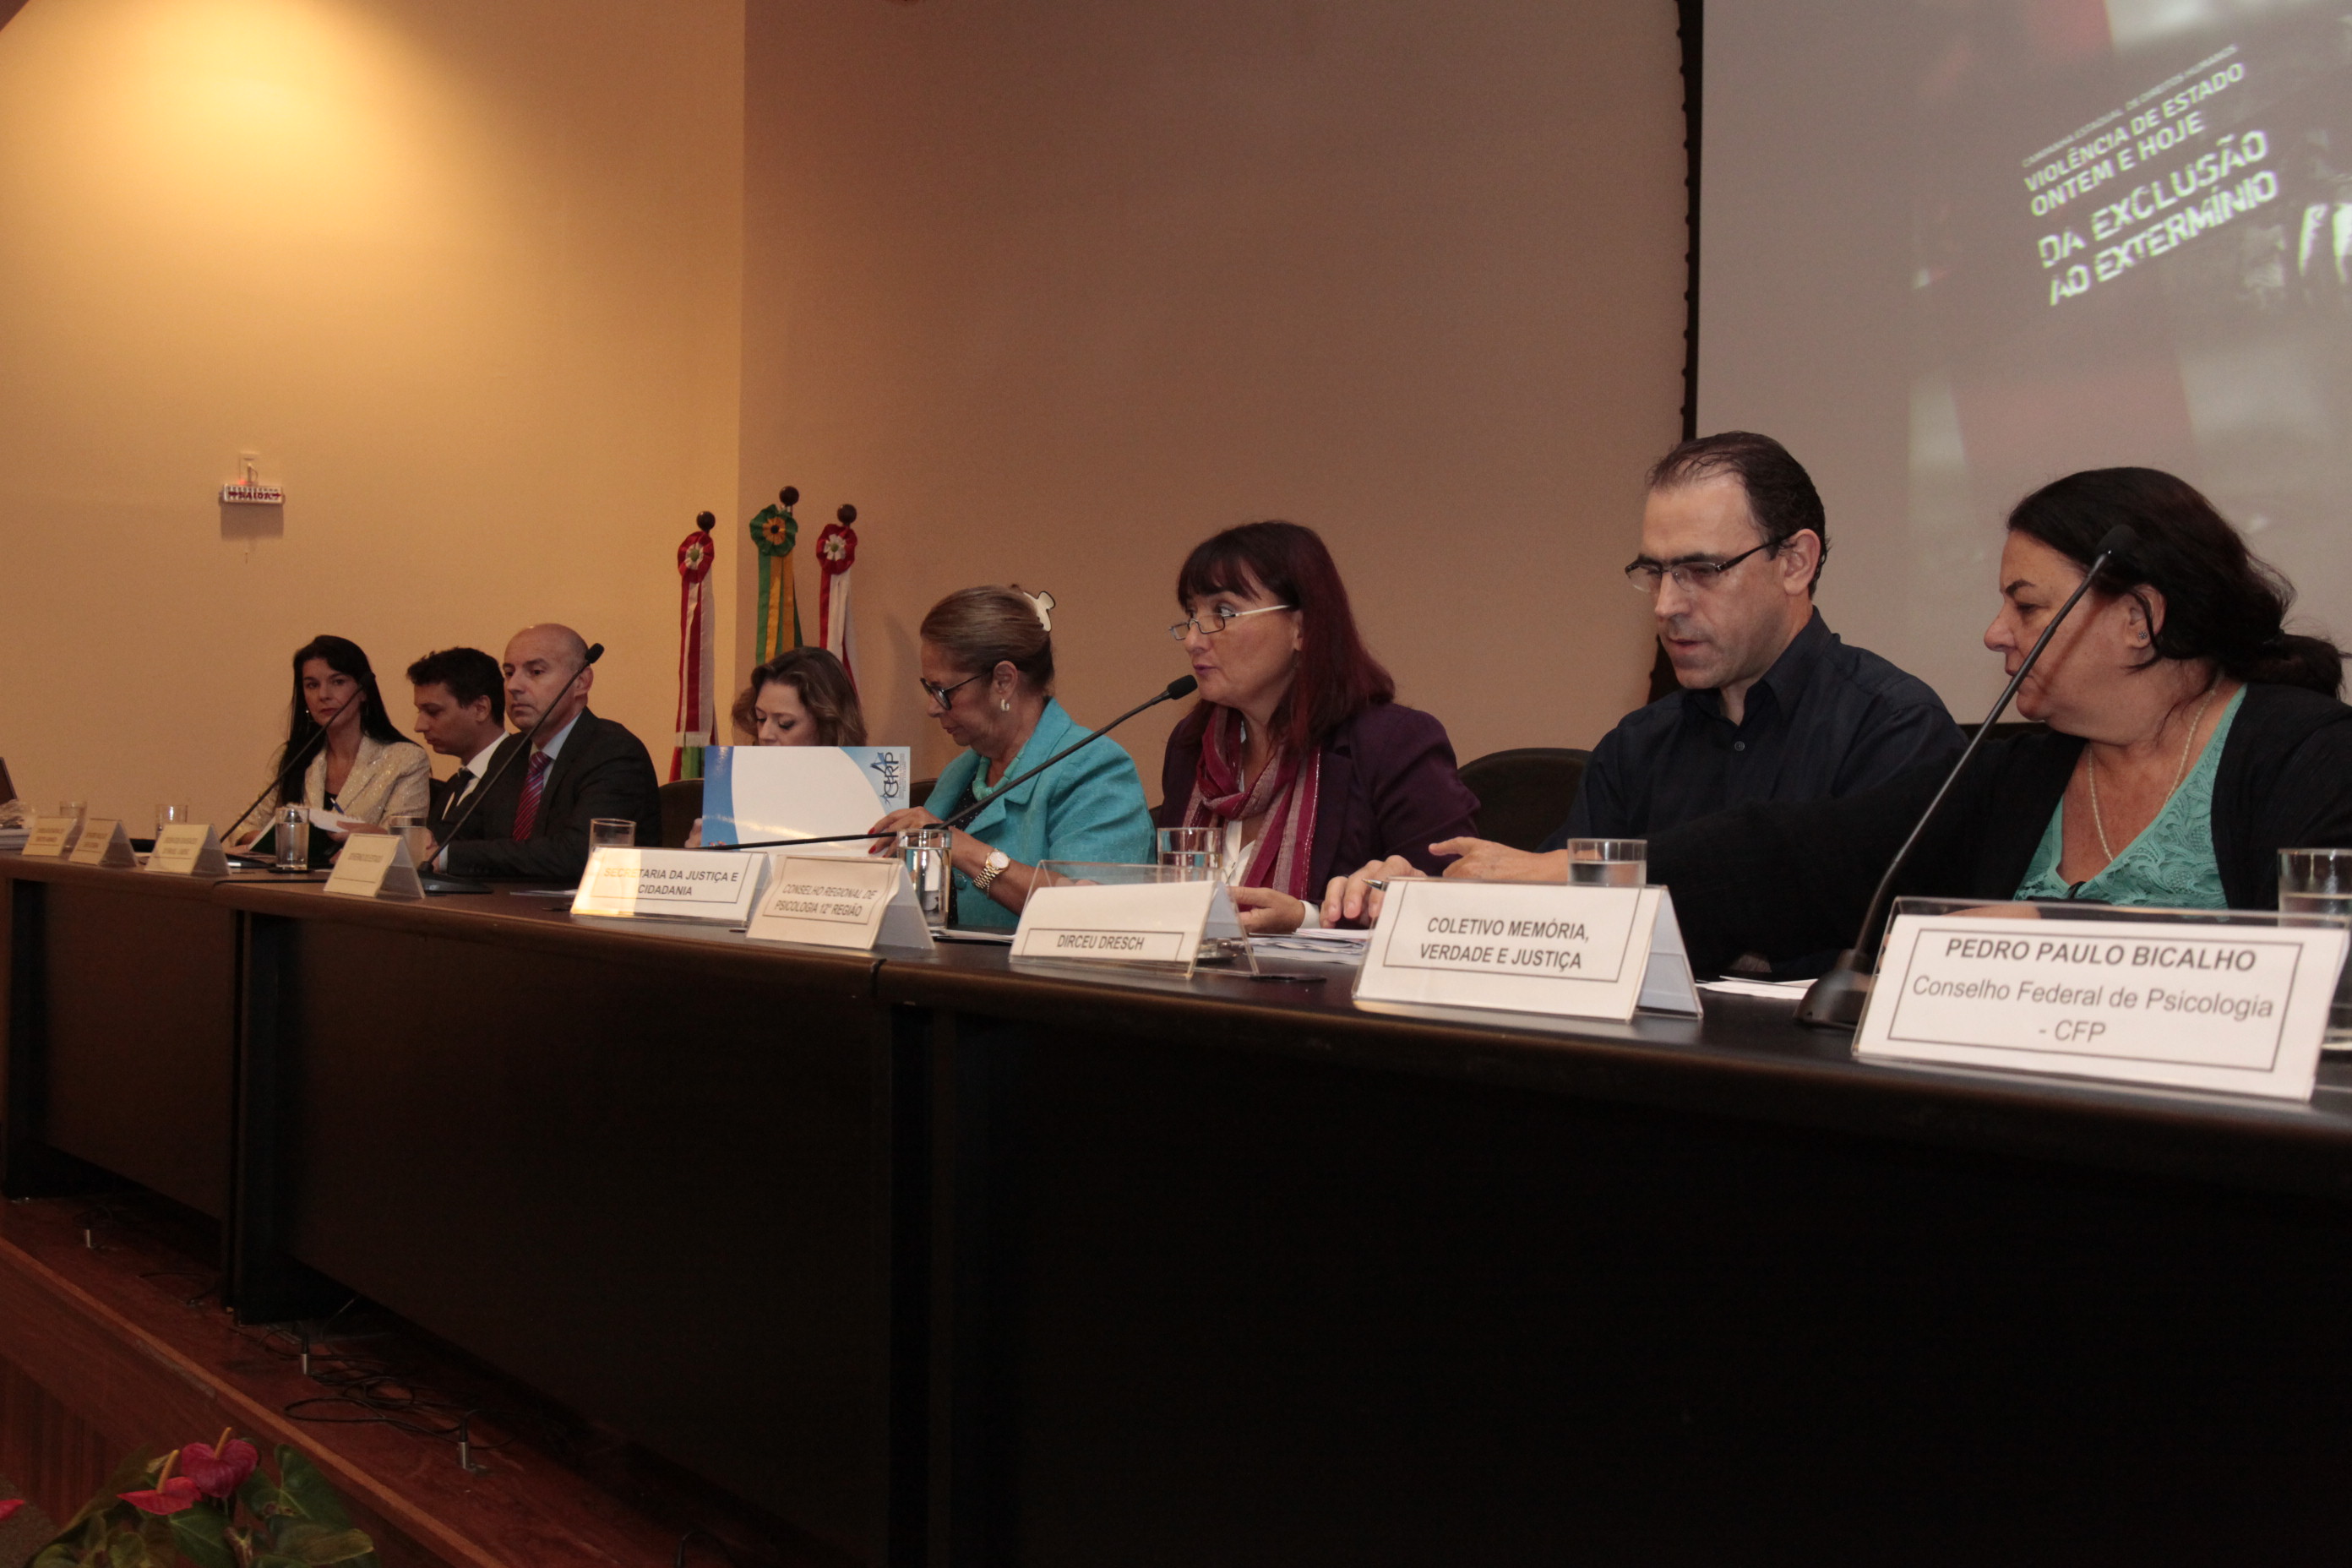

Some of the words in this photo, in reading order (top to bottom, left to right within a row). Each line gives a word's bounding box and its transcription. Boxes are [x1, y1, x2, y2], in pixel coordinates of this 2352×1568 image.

[2126, 97, 2140, 111] DE
[2139, 73, 2185, 102] DIREITOS
[2024, 127, 2129, 192] VIOLÊNCIA
[2131, 108, 2161, 136] DE
[2161, 63, 2245, 117] ESTADO
[2031, 160, 2115, 216] ONTEM
[2117, 148, 2136, 171] E
[2137, 111, 2206, 160] HOJE
[2038, 228, 2087, 269] DA
[2091, 130, 2268, 241] EXCLUSÃO
[2050, 264, 2091, 306] AO
[2095, 171, 2278, 282] EXTERMÍNIO
[603, 867, 667, 880] SECRETARIA
[669, 870, 683, 880] DA
[685, 870, 727, 883] JUSTIÇA
[730, 872, 738, 882] E
[638, 884, 693, 896] CIDADANIA
[782, 884, 823, 897] CONSELHO
[823, 886, 863, 899] REGIONAL
[865, 890, 878, 899] DE
[776, 901, 819, 912] PSICOLOGIA
[833, 903, 863, 917] REGIÃO
[1057, 934, 1095, 949] DIRCEU
[1098, 936, 1145, 950] DRESCH
[1428, 917, 1504, 936] COLETIVO
[1507, 919, 1589, 943] MEMÓRIA,
[1420, 943, 1494, 963] VERDADE
[1496, 948, 1509, 963] E
[1511, 949, 1582, 972] JUSTIÇA
[1946, 938, 2029, 961] PEDRO
[2035, 942, 2124, 965] PAULO
[2131, 945, 2257, 972] BICALHO
[1913, 975, 2010, 1002] Conselho
[2016, 981, 2102, 1007] Federal
[2109, 985, 2138, 1009] de
[2146, 988, 2274, 1021] Psicologia
[2055, 1019, 2105, 1043] CFP
